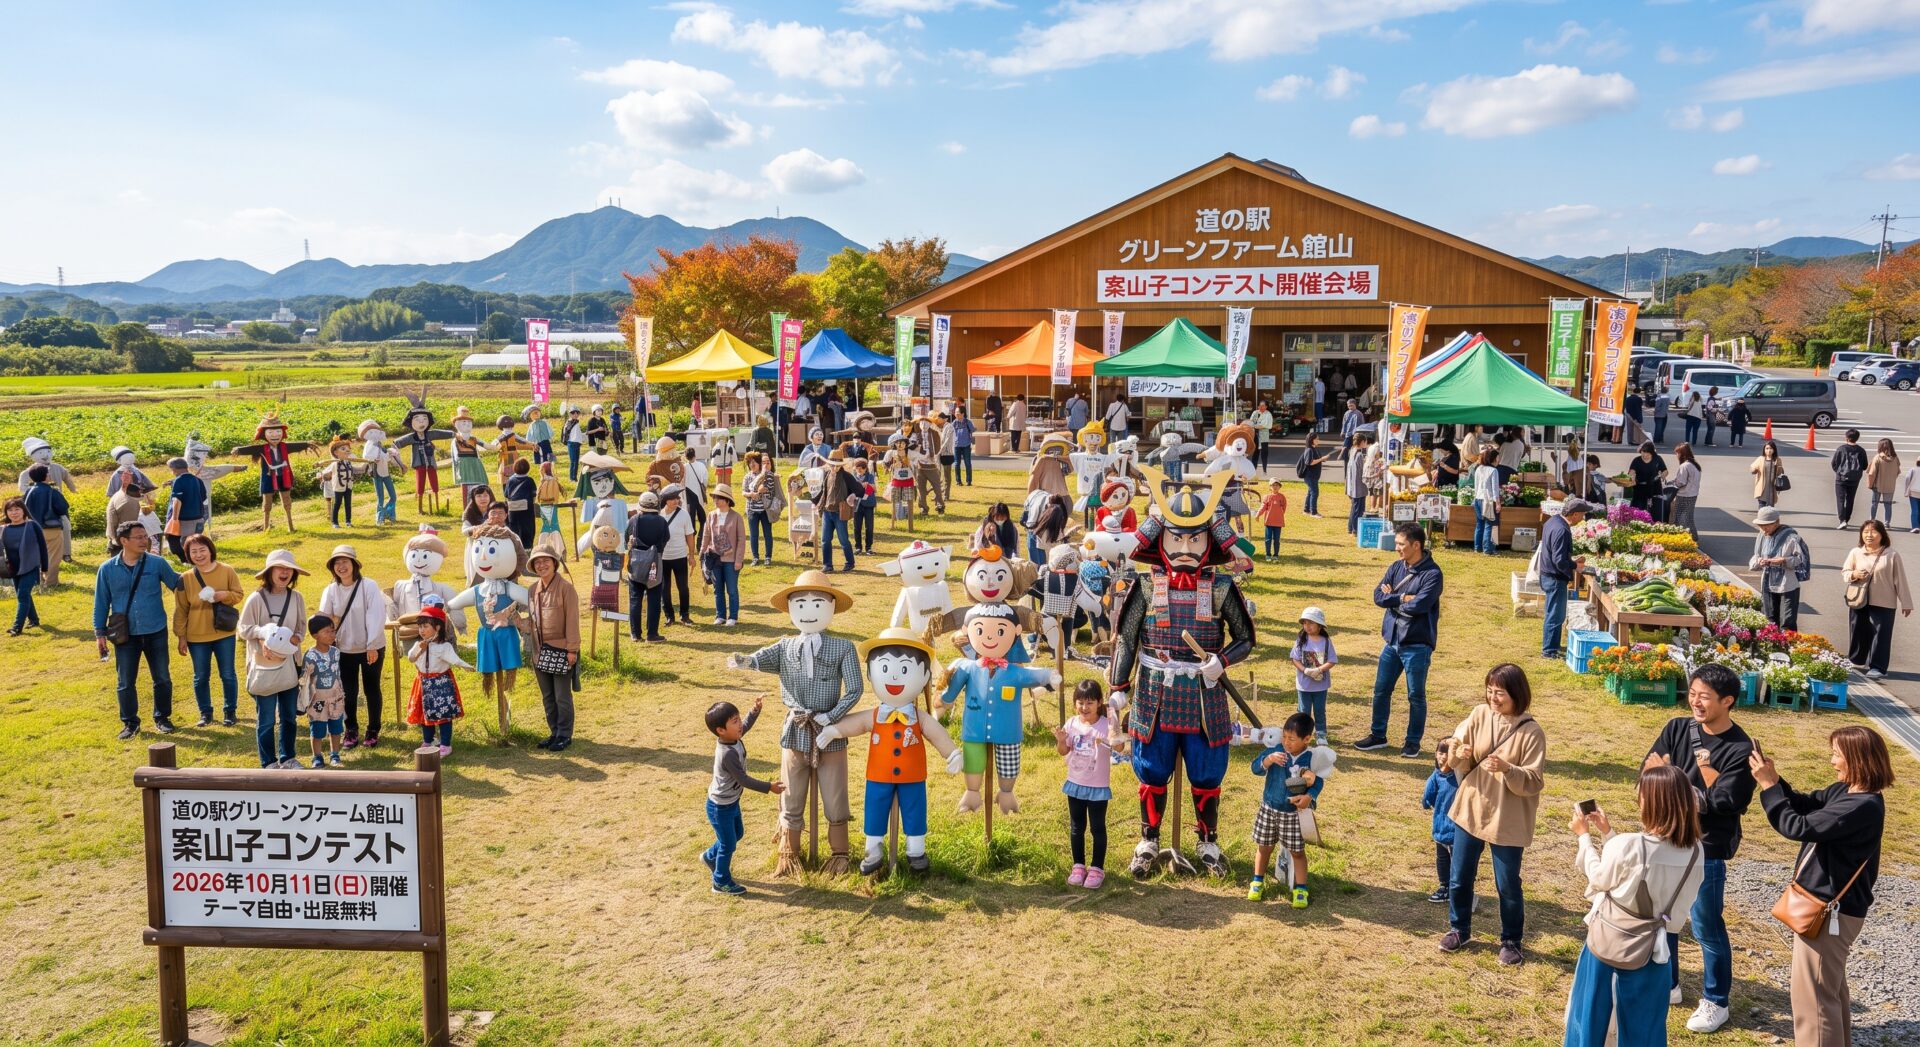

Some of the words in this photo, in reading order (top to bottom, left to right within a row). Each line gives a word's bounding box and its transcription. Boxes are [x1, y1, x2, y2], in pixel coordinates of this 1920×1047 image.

[1195, 207, 1271, 233] 道の駅
[1119, 233, 1353, 263] グリーンファーム館山
[1104, 271, 1371, 298] 案山子コンテスト開催会場
[172, 799, 404, 825] 道の駅グリーンファーム館山
[172, 827, 406, 864] 案山子コンテスト
[172, 872, 409, 897] 2026年10月11日(日)開催
[203, 899, 378, 921] テーマ自由・出展無料
